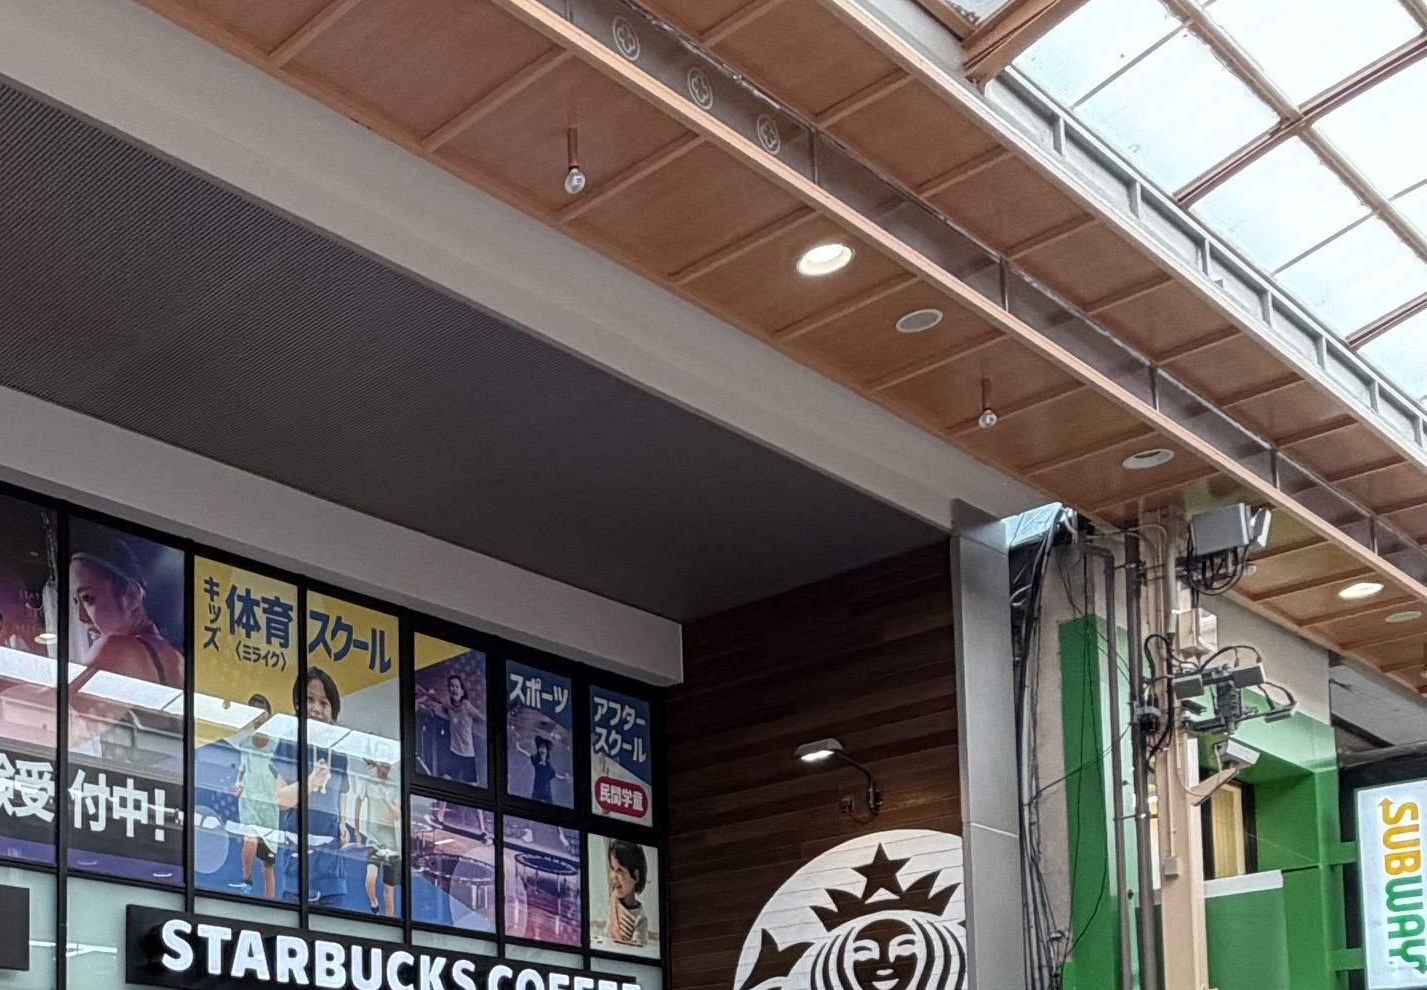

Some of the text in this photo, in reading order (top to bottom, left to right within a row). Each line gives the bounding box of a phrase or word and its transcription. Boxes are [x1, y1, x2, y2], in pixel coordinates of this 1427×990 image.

[203, 576, 221, 652] キッズ
[509, 673, 569, 713] スポーツ
[593, 697, 646, 731] アフター
[594, 726, 647, 763] スクール
[599, 782, 644, 812] 民間学童
[1378, 797, 1427, 975] SUBWAY
